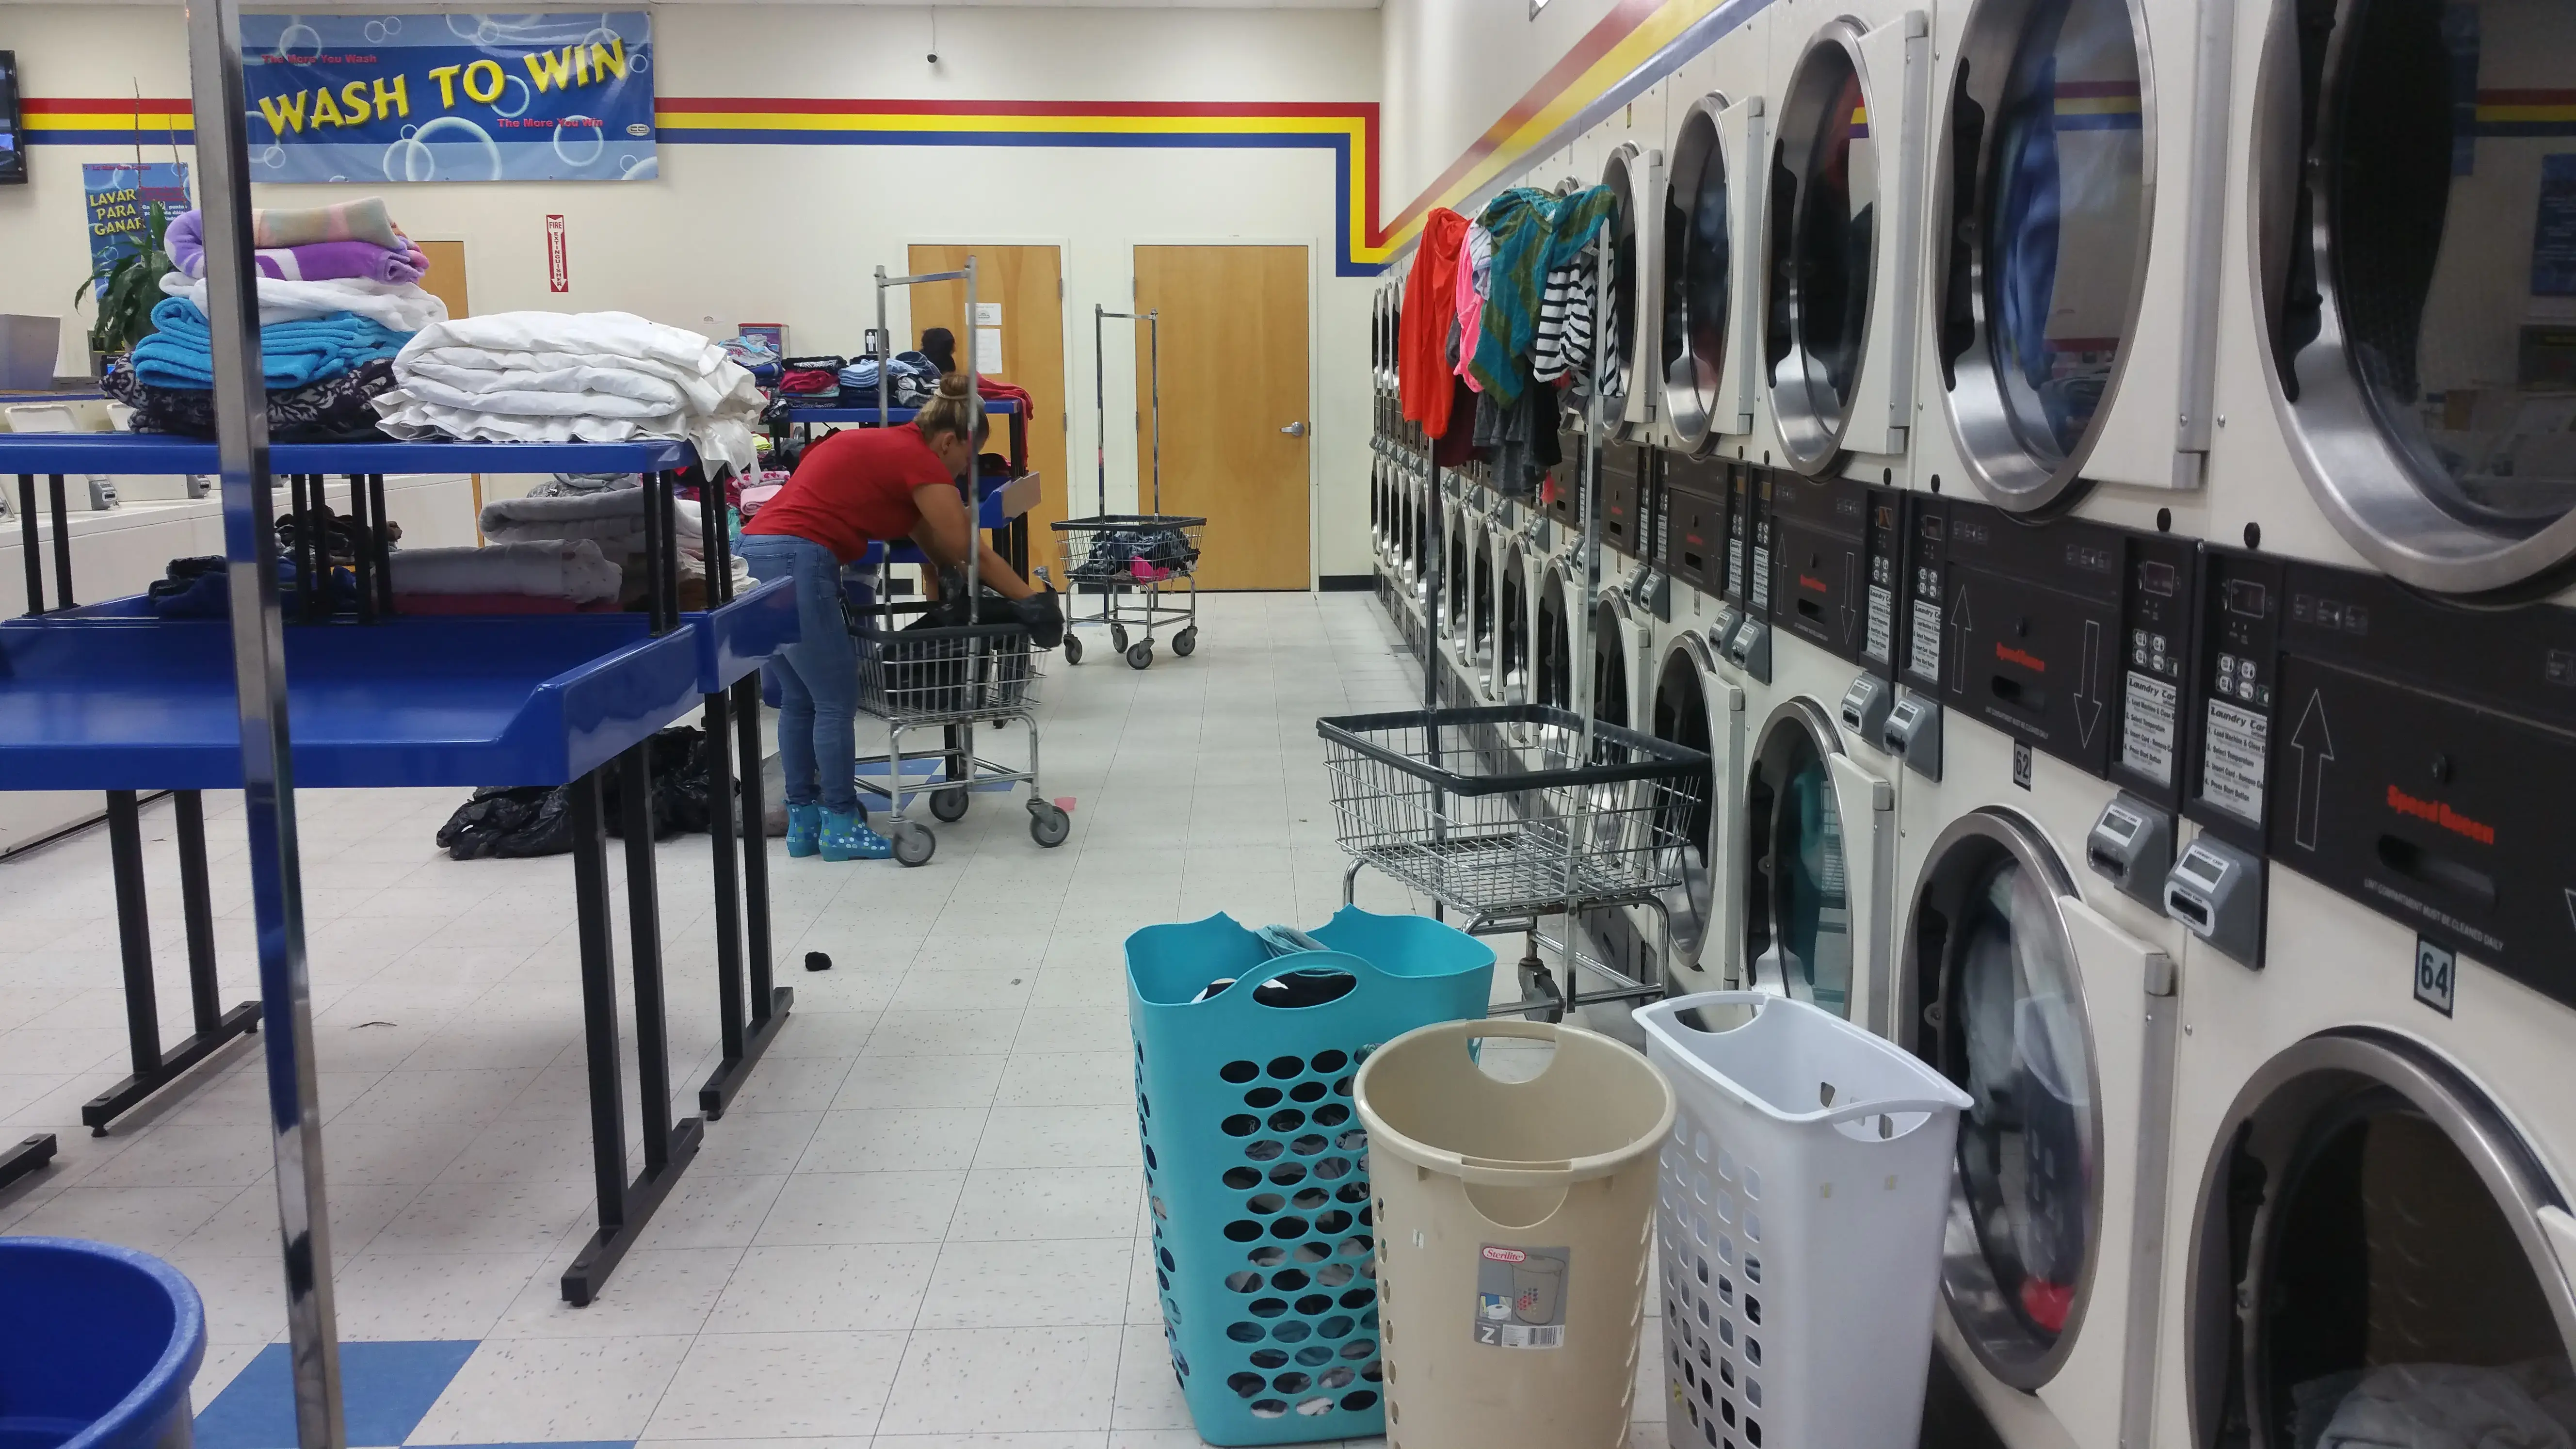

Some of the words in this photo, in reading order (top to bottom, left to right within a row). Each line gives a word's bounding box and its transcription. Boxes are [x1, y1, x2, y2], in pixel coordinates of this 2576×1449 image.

[261, 54, 284, 64] The
[288, 54, 316, 64] More
[320, 54, 341, 63] You
[345, 54, 377, 63] Wash
[258, 73, 409, 136] WASH
[429, 60, 506, 109] TO
[523, 37, 627, 94] WIN
[497, 118, 519, 128] The
[523, 118, 553, 127] More
[557, 118, 578, 127] You
[581, 118, 603, 127] Win
[89, 189, 137, 207] LAVAR
[96, 203, 136, 221] PARA
[2129, 678, 2159, 696] Laundry
[2162, 690, 2175, 701] Car
[2210, 707, 2247, 727] Laundry
[2250, 719, 2266, 731] Car
[2016, 751, 2028, 779] 62
[2452, 918, 2482, 941] CLEANED
[2421, 951, 2448, 999] 64
[1486, 1249, 1520, 1260] Sterilite
[1481, 1326, 1495, 1344] Z
